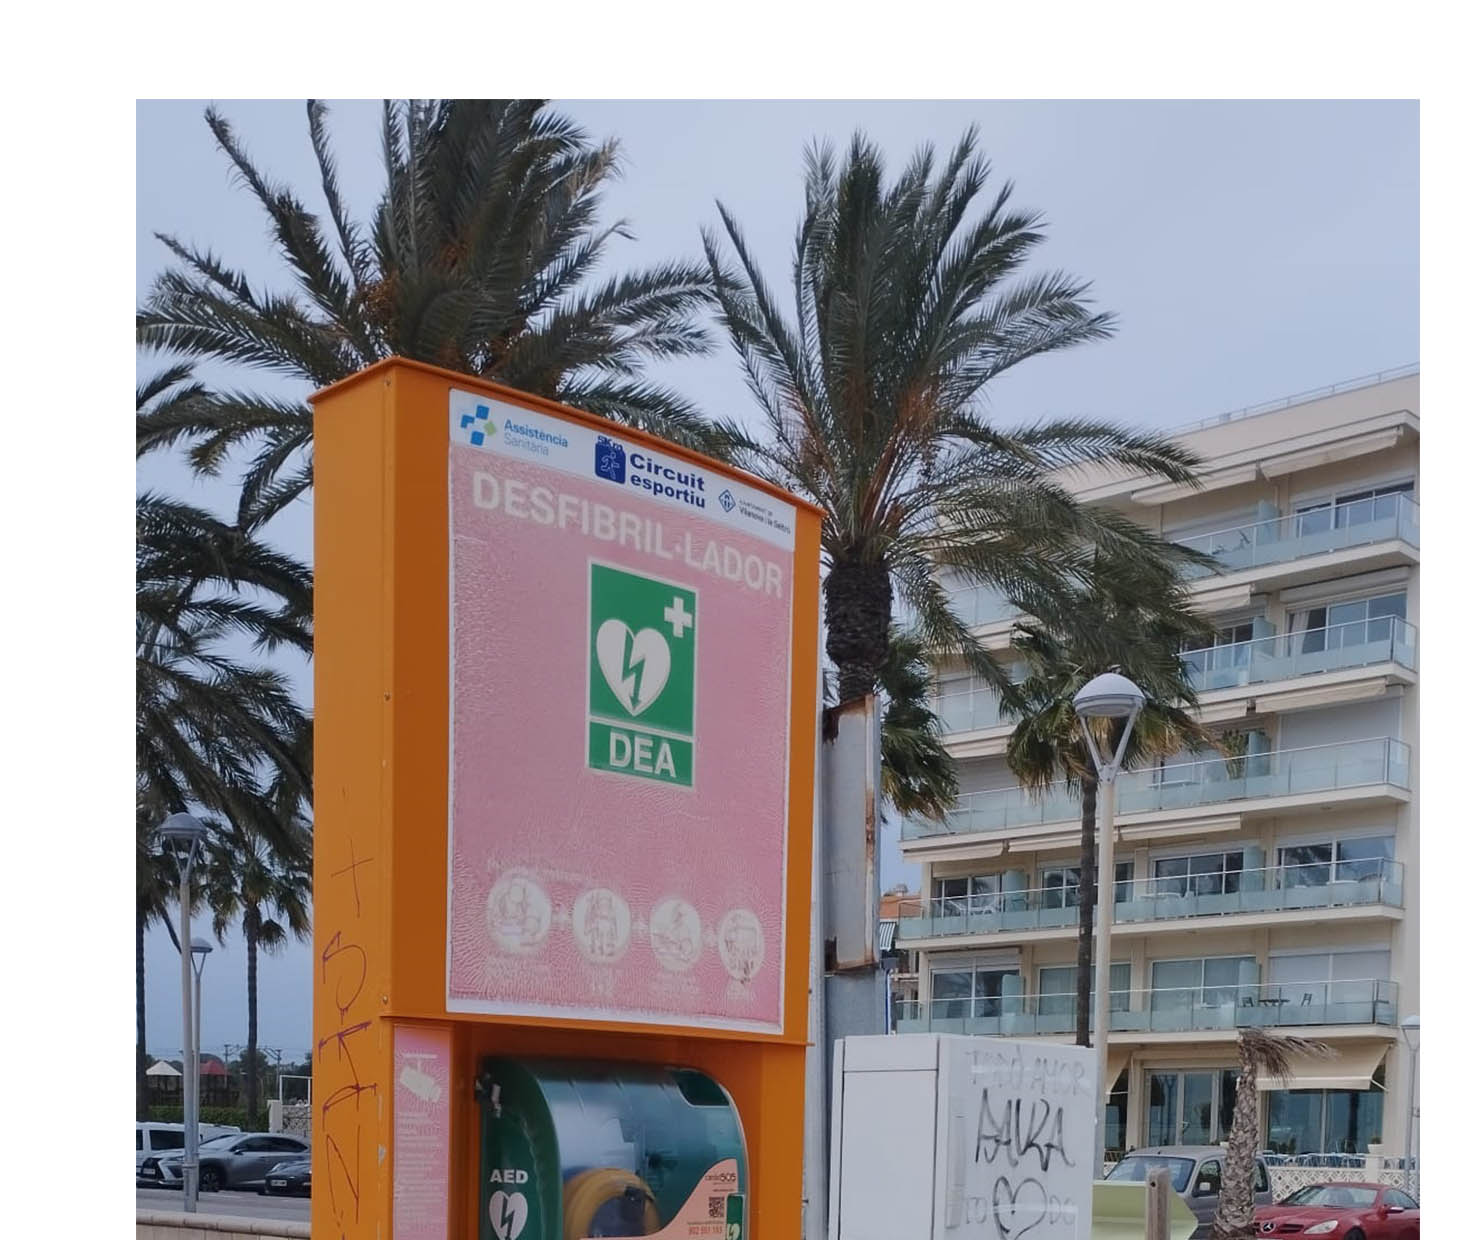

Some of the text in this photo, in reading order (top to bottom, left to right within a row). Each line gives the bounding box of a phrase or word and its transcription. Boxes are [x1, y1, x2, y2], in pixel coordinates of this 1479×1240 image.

[629, 453, 705, 492] Circuit
[630, 473, 706, 509] esportiu
[609, 731, 677, 778] DEA
[490, 1169, 528, 1184] AED
